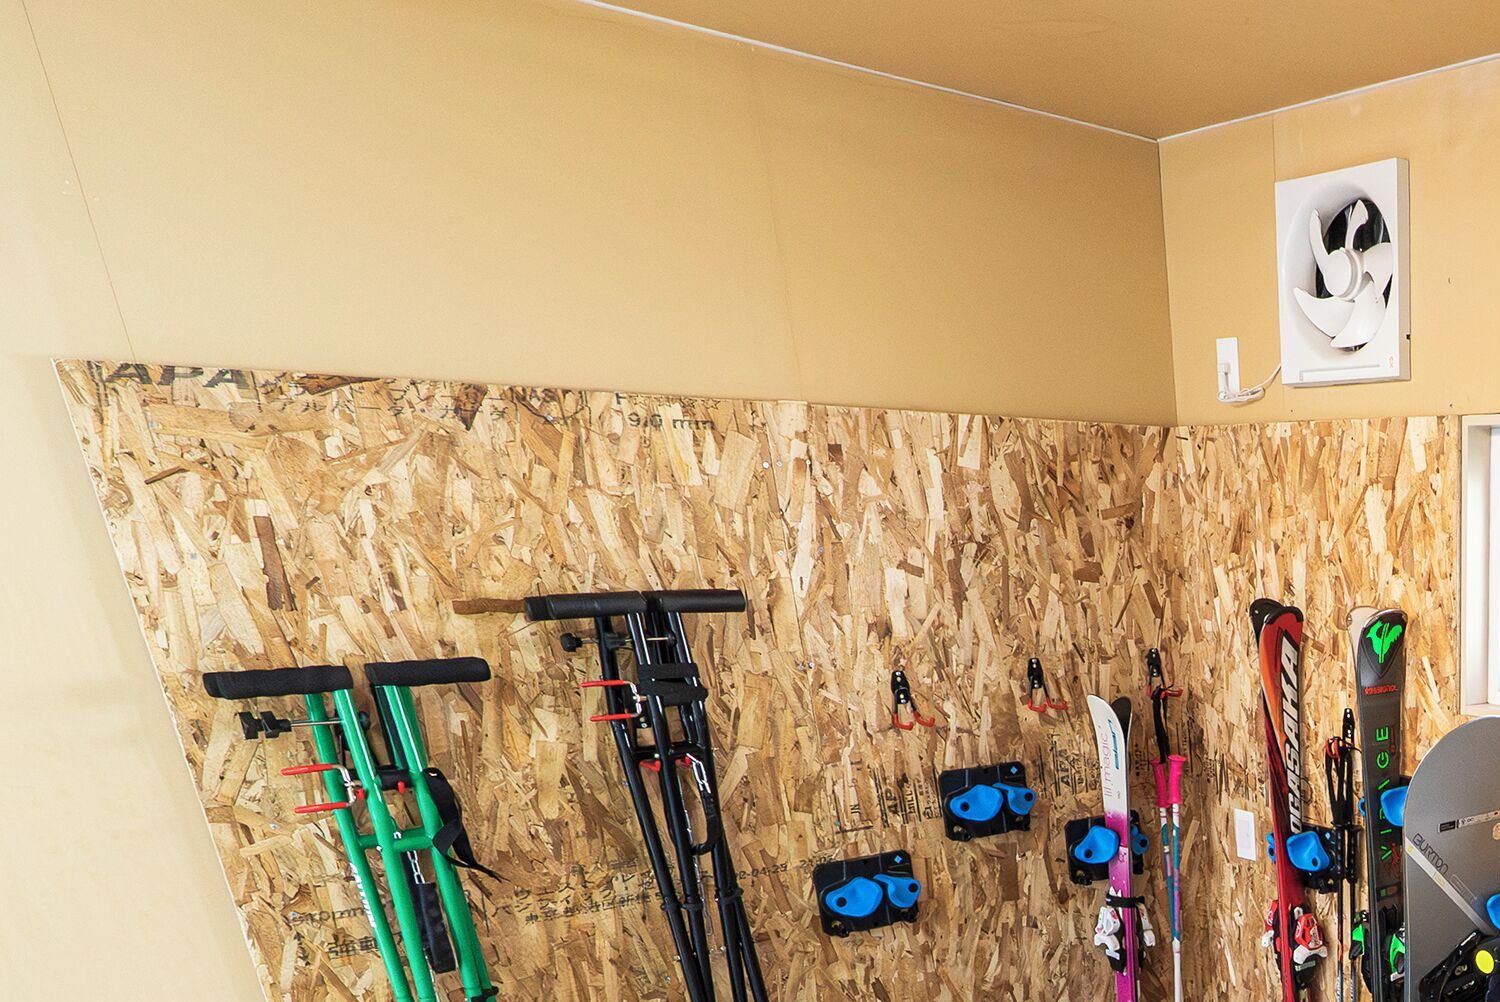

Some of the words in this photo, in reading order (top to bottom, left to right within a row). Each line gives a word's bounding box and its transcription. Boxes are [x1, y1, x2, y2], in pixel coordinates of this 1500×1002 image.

[105, 363, 249, 389] APA
[1281, 635, 1302, 833] OGASAKA
[1411, 833, 1449, 874] BURTON
